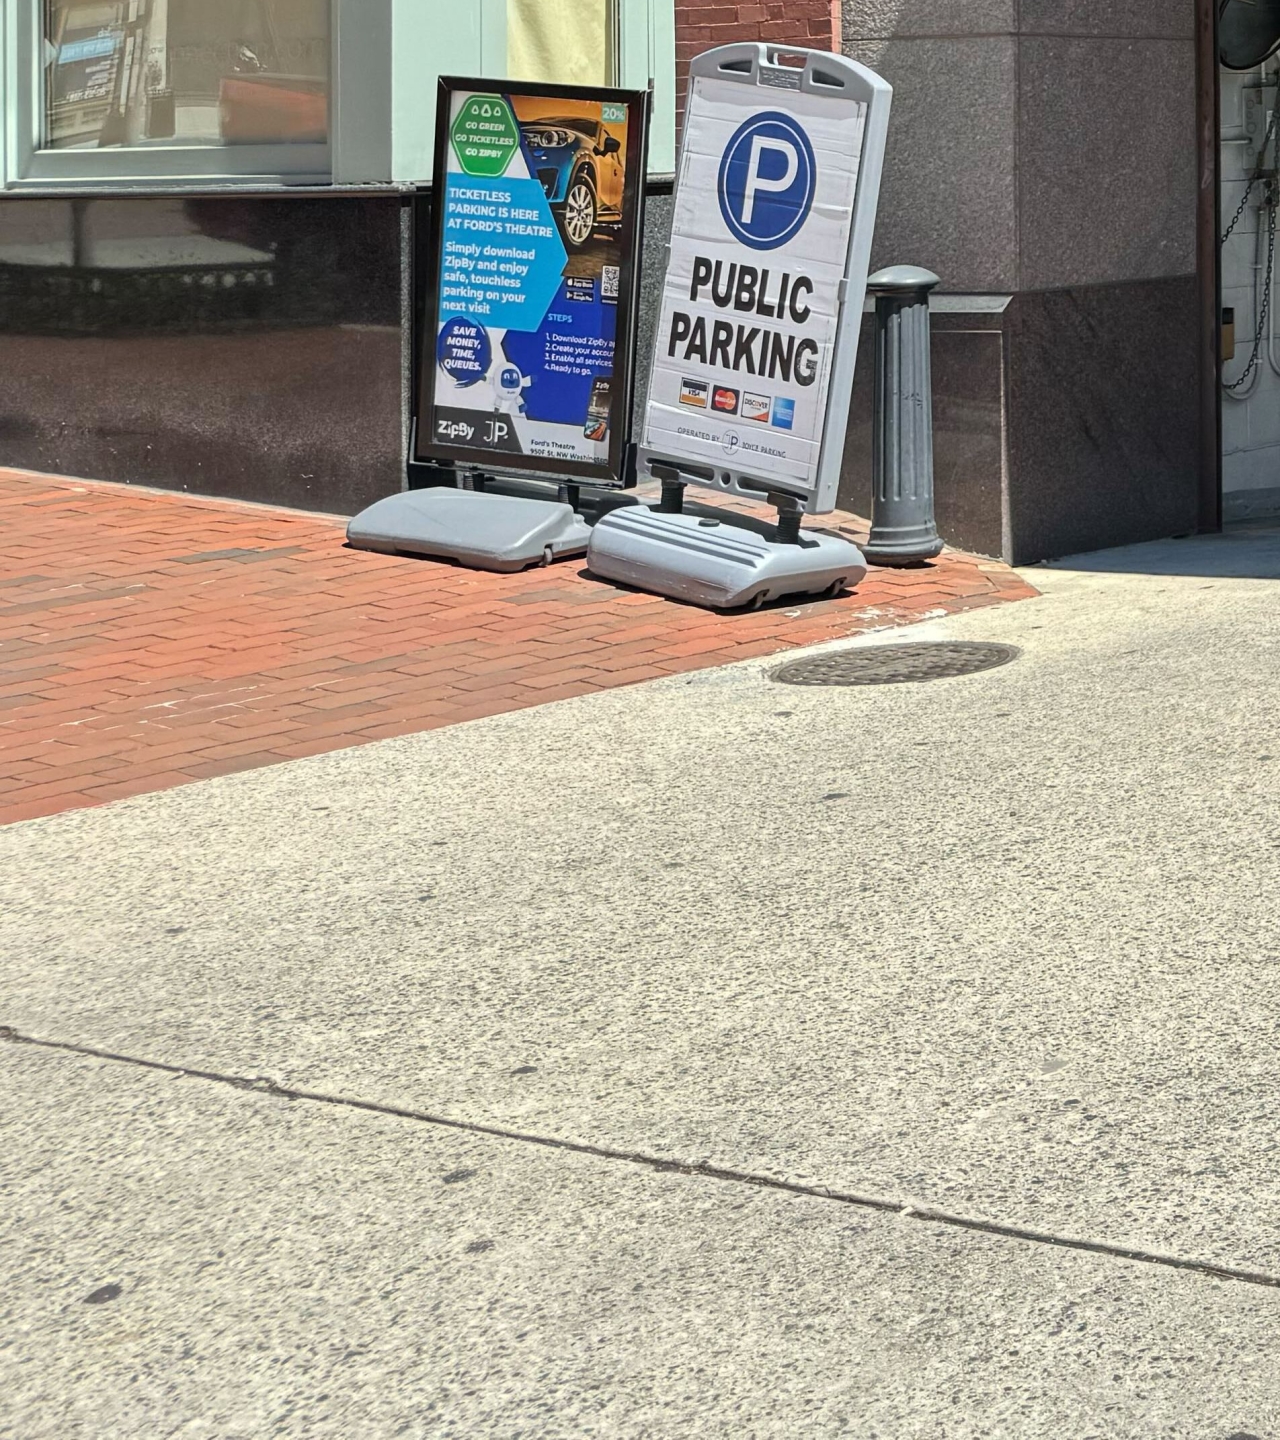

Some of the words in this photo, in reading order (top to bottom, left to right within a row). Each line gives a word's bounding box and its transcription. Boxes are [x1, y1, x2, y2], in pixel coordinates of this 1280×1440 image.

[603, 108, 625, 120] 20%
[465, 121, 477, 129] GO
[479, 122, 505, 131] GREEN
[455, 134, 467, 142] GO
[469, 135, 514, 145] TICKETLESS
[465, 148, 477, 156] GO
[479, 150, 502, 158] ZIPBY
[742, 135, 799, 224] P
[449, 188, 511, 202] TICKETLESS
[449, 203, 496, 217] PARKING
[498, 206, 508, 217] IS
[511, 209, 539, 220] HERE
[448, 219, 462, 228] AT
[464, 220, 502, 233] FORD'S
[505, 224, 553, 237] THEATRE
[446, 242, 481, 257] Simply
[483, 245, 535, 259] download
[445, 256, 475, 271] ZipBy
[477, 259, 497, 270] and
[500, 262, 528, 274] enjoy
[444, 272, 469, 283] safe,
[471, 275, 521, 288] touchless
[443, 286, 483, 300] parking
[486, 292, 499, 300] on
[502, 294, 526, 304] your
[689, 256, 814, 324] PUBLIC
[442, 302, 466, 311] next
[468, 303, 490, 314] visit
[548, 314, 573, 323] STEPS
[453, 326, 477, 336] SAVE
[447, 337, 481, 349] MONEY,
[552, 334, 586, 344] Download
[588, 338, 607, 347] ZipBy
[452, 349, 475, 359] TIME,
[667, 311, 819, 386] PARKING
[551, 353, 575, 363] Enable
[444, 359, 482, 371] QUEUES.
[745, 398, 768, 409] DISCOVER
[438, 420, 474, 440] ZipBy
[552, 441, 575, 450] Theatre
[677, 427, 710, 440] OPERATED
[760, 446, 786, 458] PARKING
